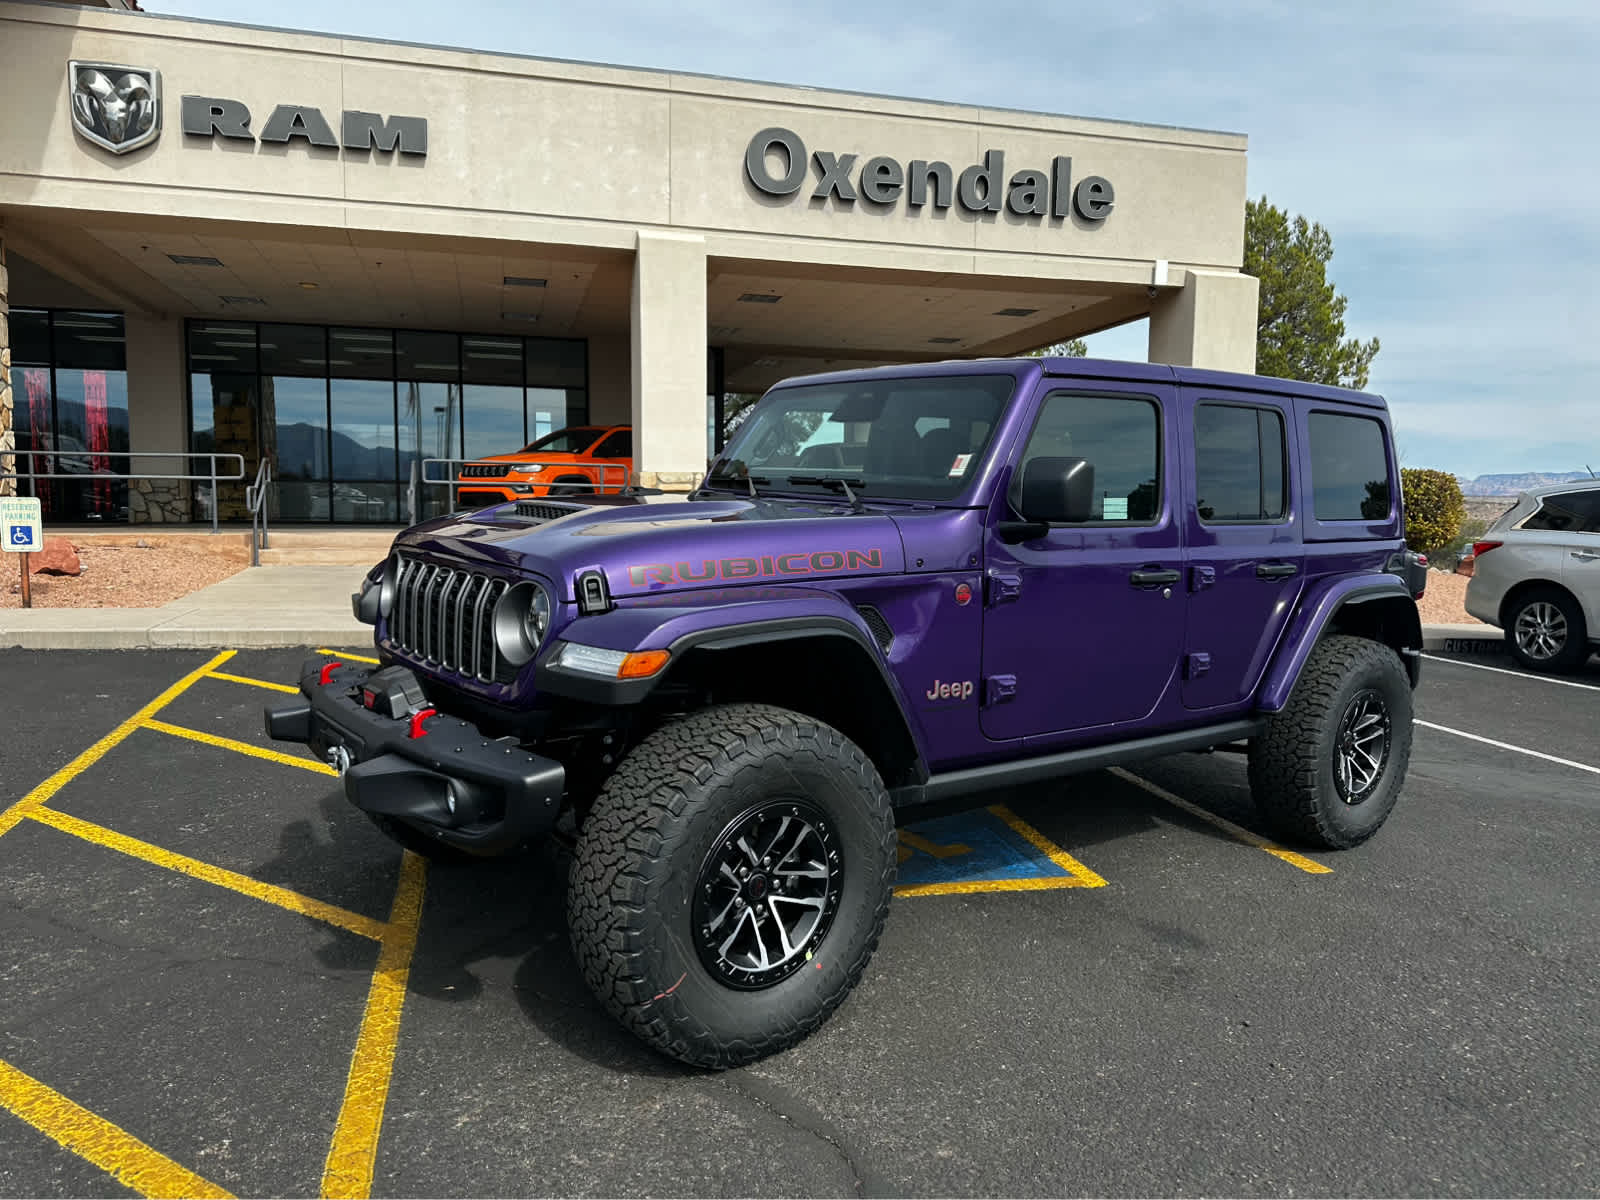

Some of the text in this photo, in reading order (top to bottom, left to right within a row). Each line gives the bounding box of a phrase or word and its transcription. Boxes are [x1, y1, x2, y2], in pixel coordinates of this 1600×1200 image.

[181, 95, 427, 156] RAM
[745, 127, 1115, 221] Oxendale
[5, 512, 36, 520] PARKING
[628, 549, 882, 587] RUBICON
[927, 679, 974, 700] Jeep
